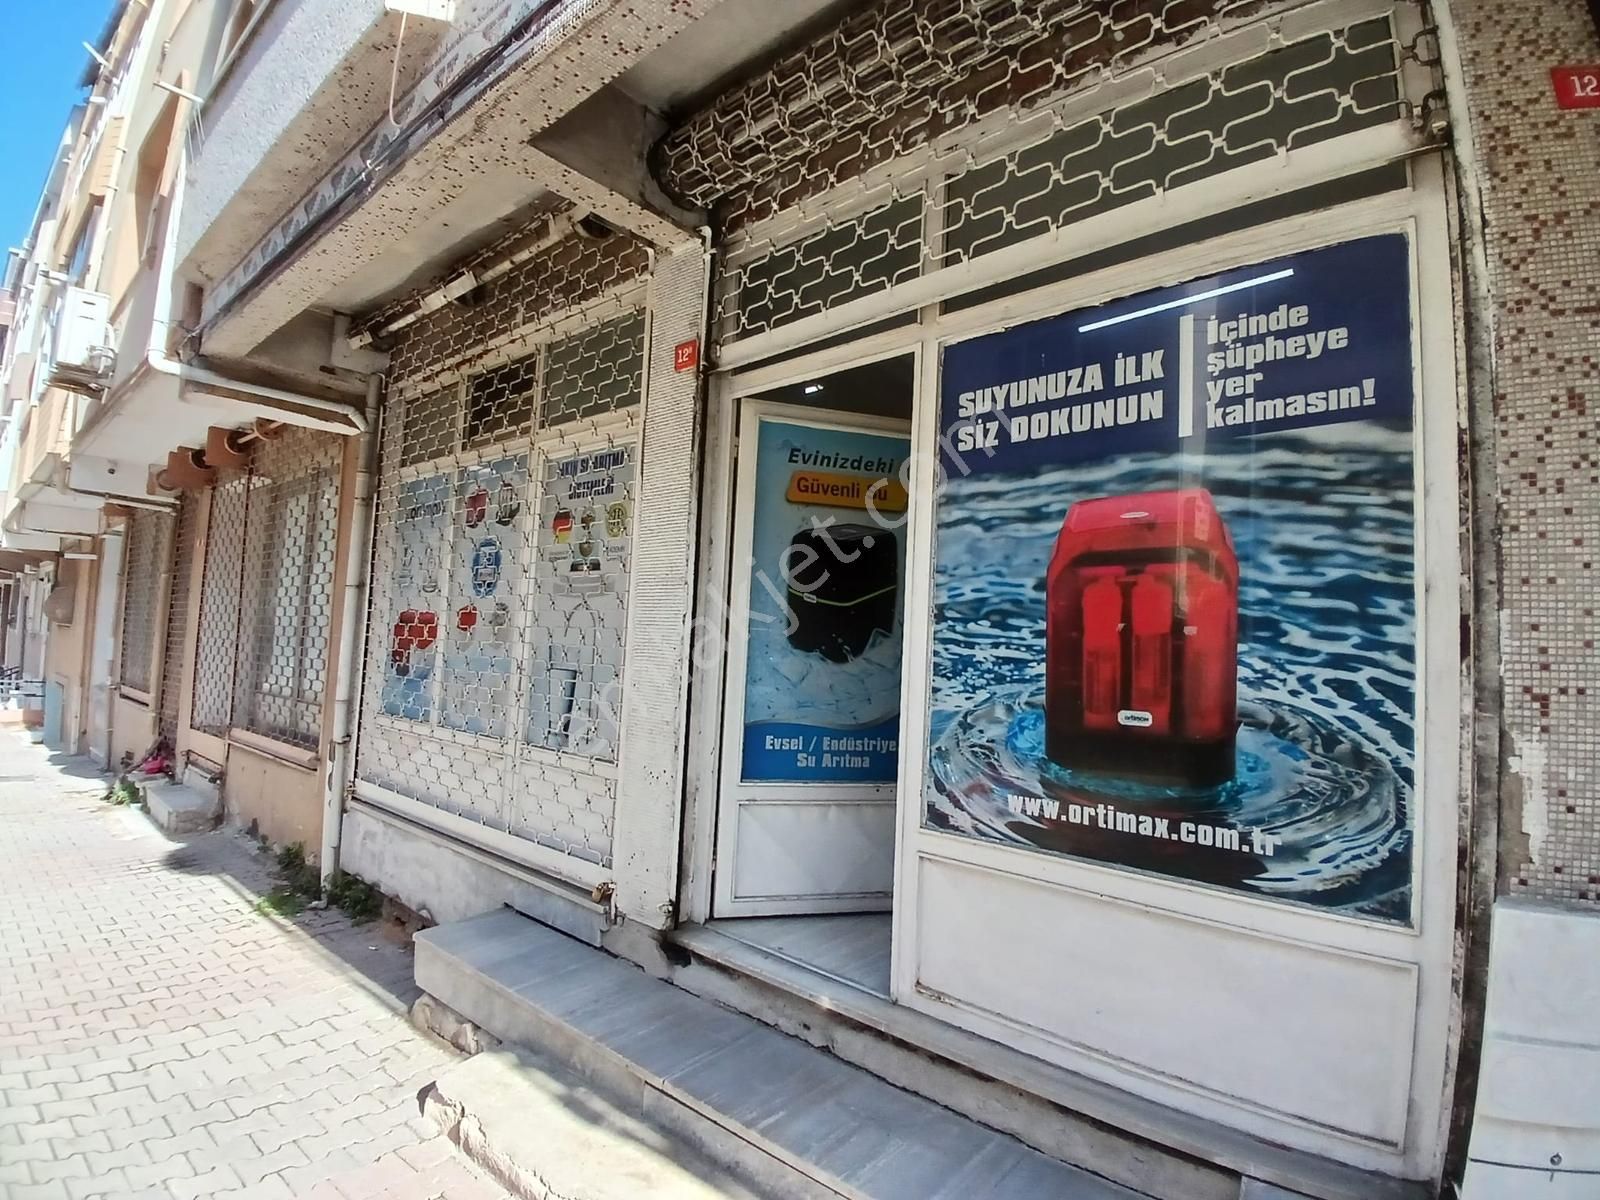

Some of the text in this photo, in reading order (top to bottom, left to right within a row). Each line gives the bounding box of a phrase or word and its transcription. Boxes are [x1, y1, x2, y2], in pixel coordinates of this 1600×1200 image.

[1570, 75, 1600, 97] 12
[1207, 304, 1309, 346] İçinde
[1207, 327, 1349, 376] şüpheye
[958, 349, 1165, 418] SUYUNUZA İLK
[1206, 372, 1264, 405] yer
[958, 390, 1164, 452] SİZ DOKUNUN
[1207, 377, 1377, 429] kalmasın!
[788, 448, 894, 474] Evinizdeki
[796, 476, 860, 499] Güvenli
[765, 735, 803, 750] Evsel
[797, 752, 870, 768] Su Arıtma
[1007, 793, 1282, 856] www.ortimax.com.tr
